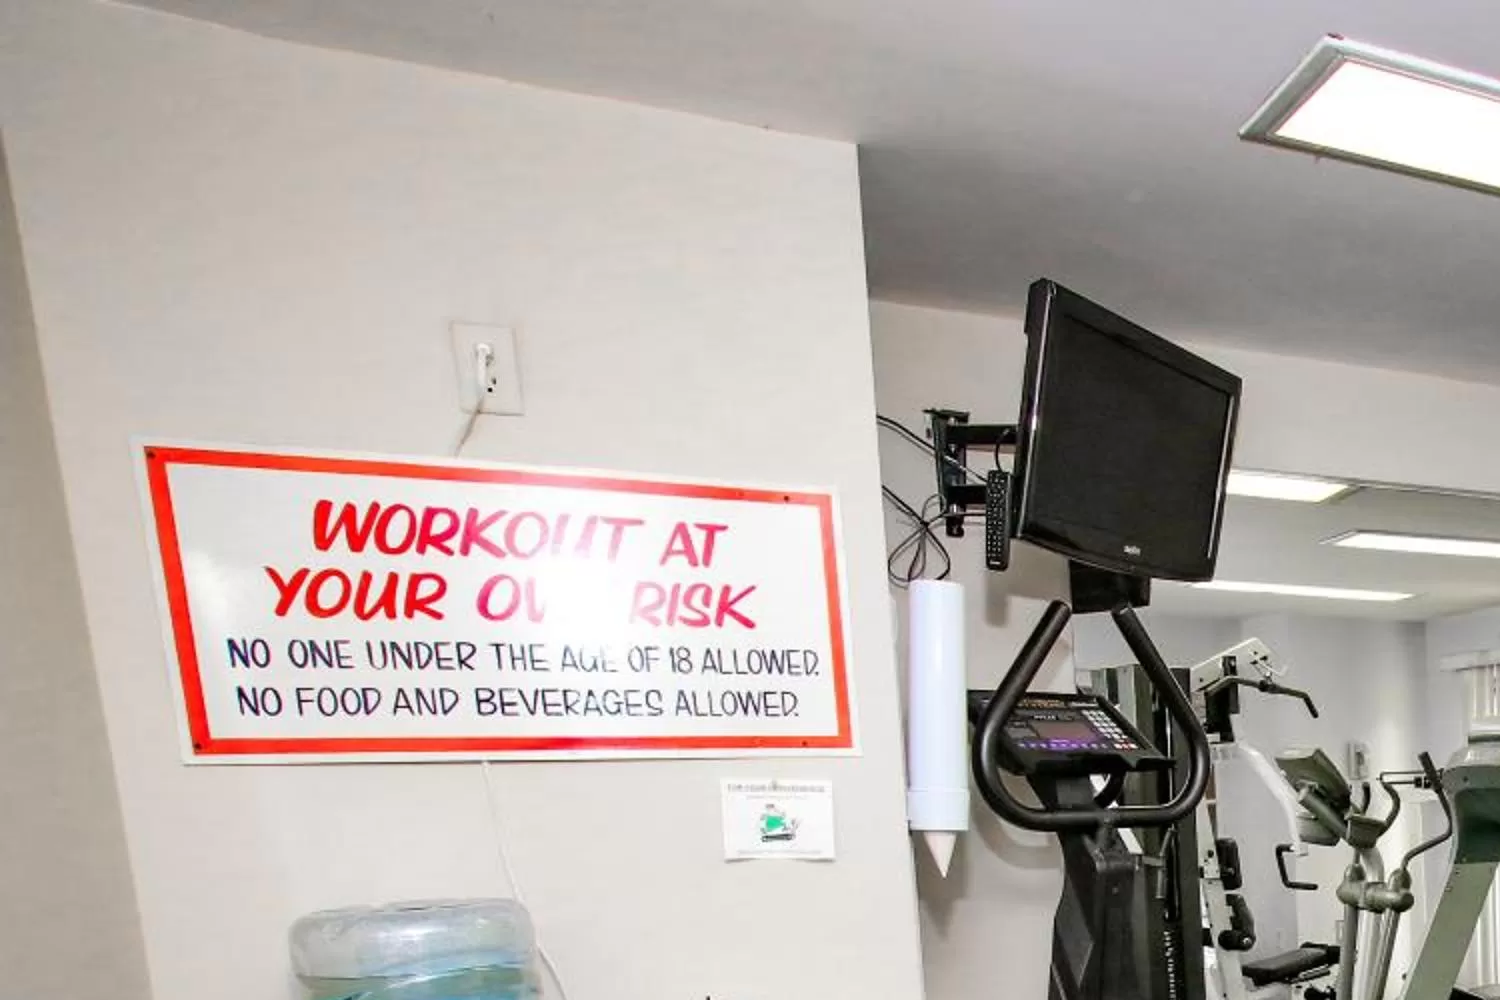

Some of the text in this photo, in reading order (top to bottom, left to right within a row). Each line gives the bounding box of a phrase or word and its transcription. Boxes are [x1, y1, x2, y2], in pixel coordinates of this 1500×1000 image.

[659, 521, 727, 567] AT
[263, 565, 448, 622] YOUR
[629, 580, 758, 629] RISK
[226, 638, 271, 669] NO
[287, 639, 354, 669] ONE
[365, 640, 477, 671] UNDER
[489, 643, 551, 672] THE
[627, 646, 660, 674] OF
[669, 646, 693, 674] 18
[700, 649, 820, 676] ALLOWED.
[236, 686, 799, 717] NO FOOD AND BEVERAGES ALLOWED.
